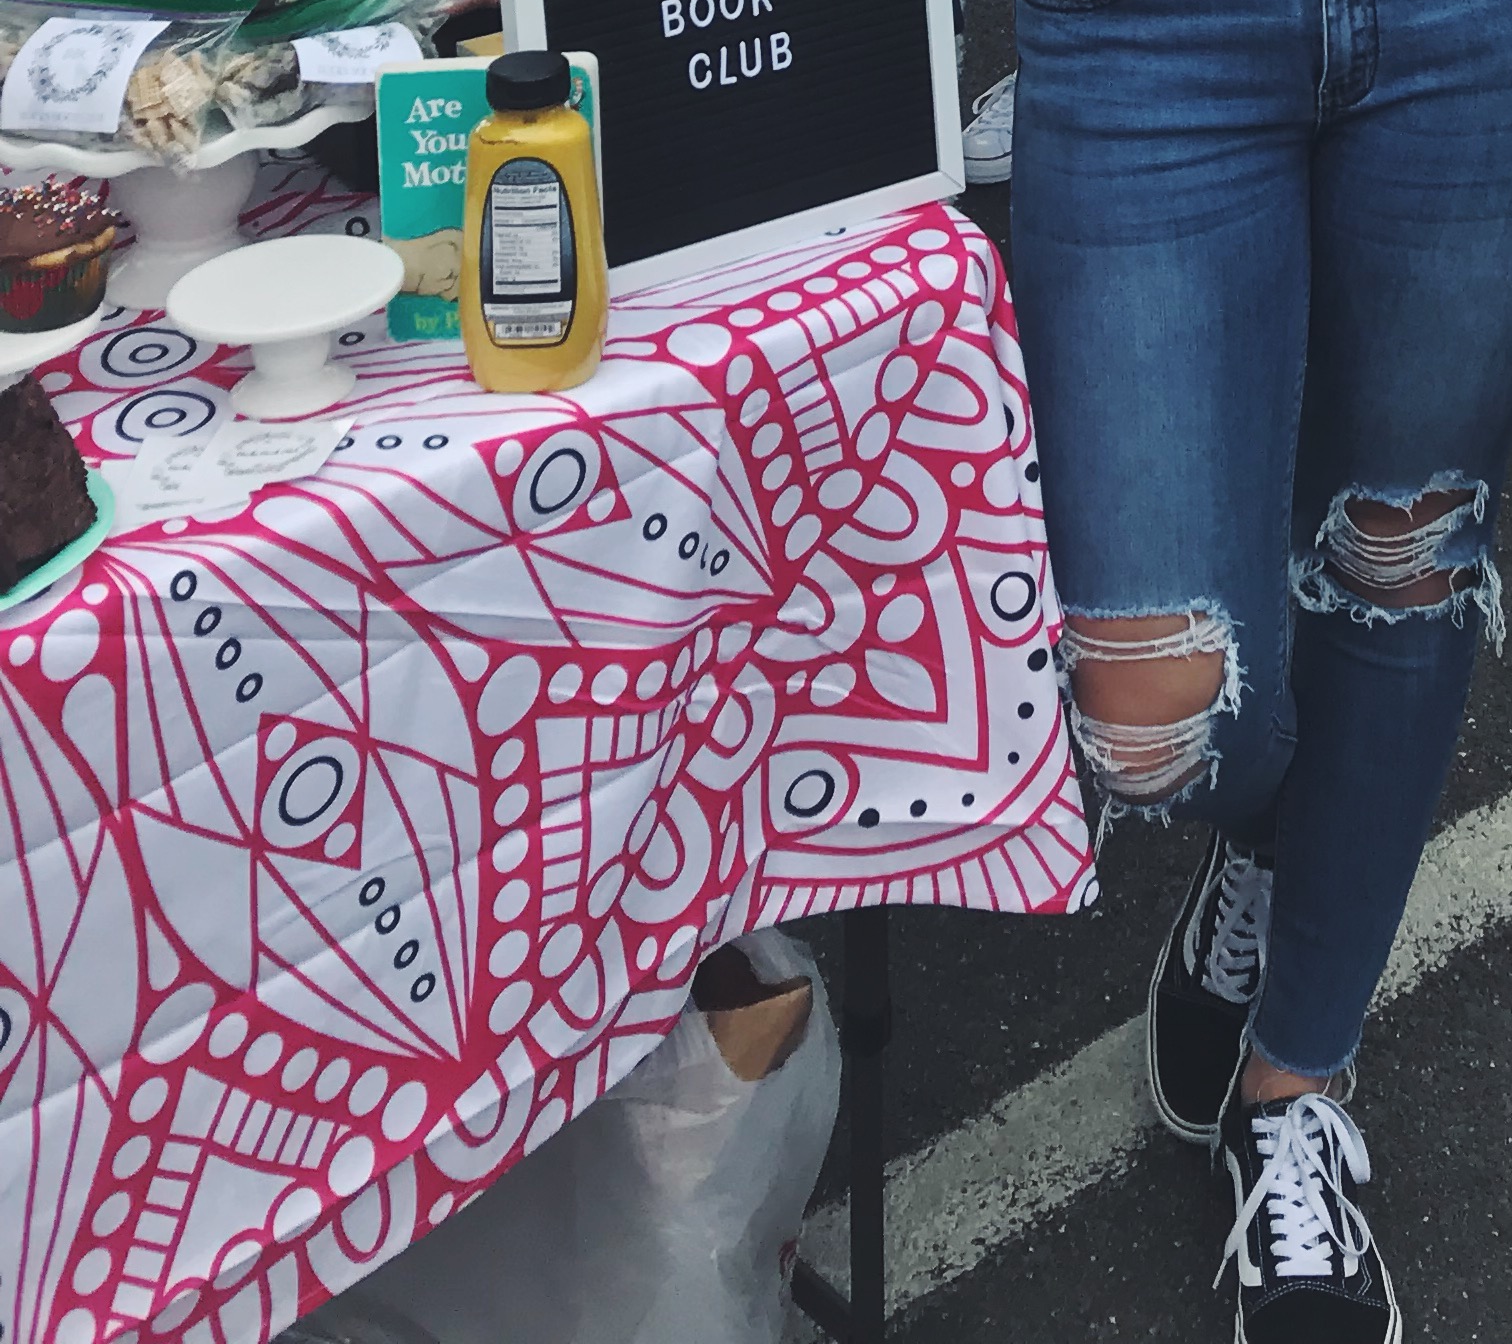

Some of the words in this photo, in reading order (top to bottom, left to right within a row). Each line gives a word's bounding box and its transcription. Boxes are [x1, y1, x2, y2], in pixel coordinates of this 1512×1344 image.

[688, 31, 793, 89] CLUB
[404, 96, 463, 124] Are
[410, 129, 467, 155] You
[493, 186, 531, 195] Nutrition
[532, 184, 557, 194] Facts
